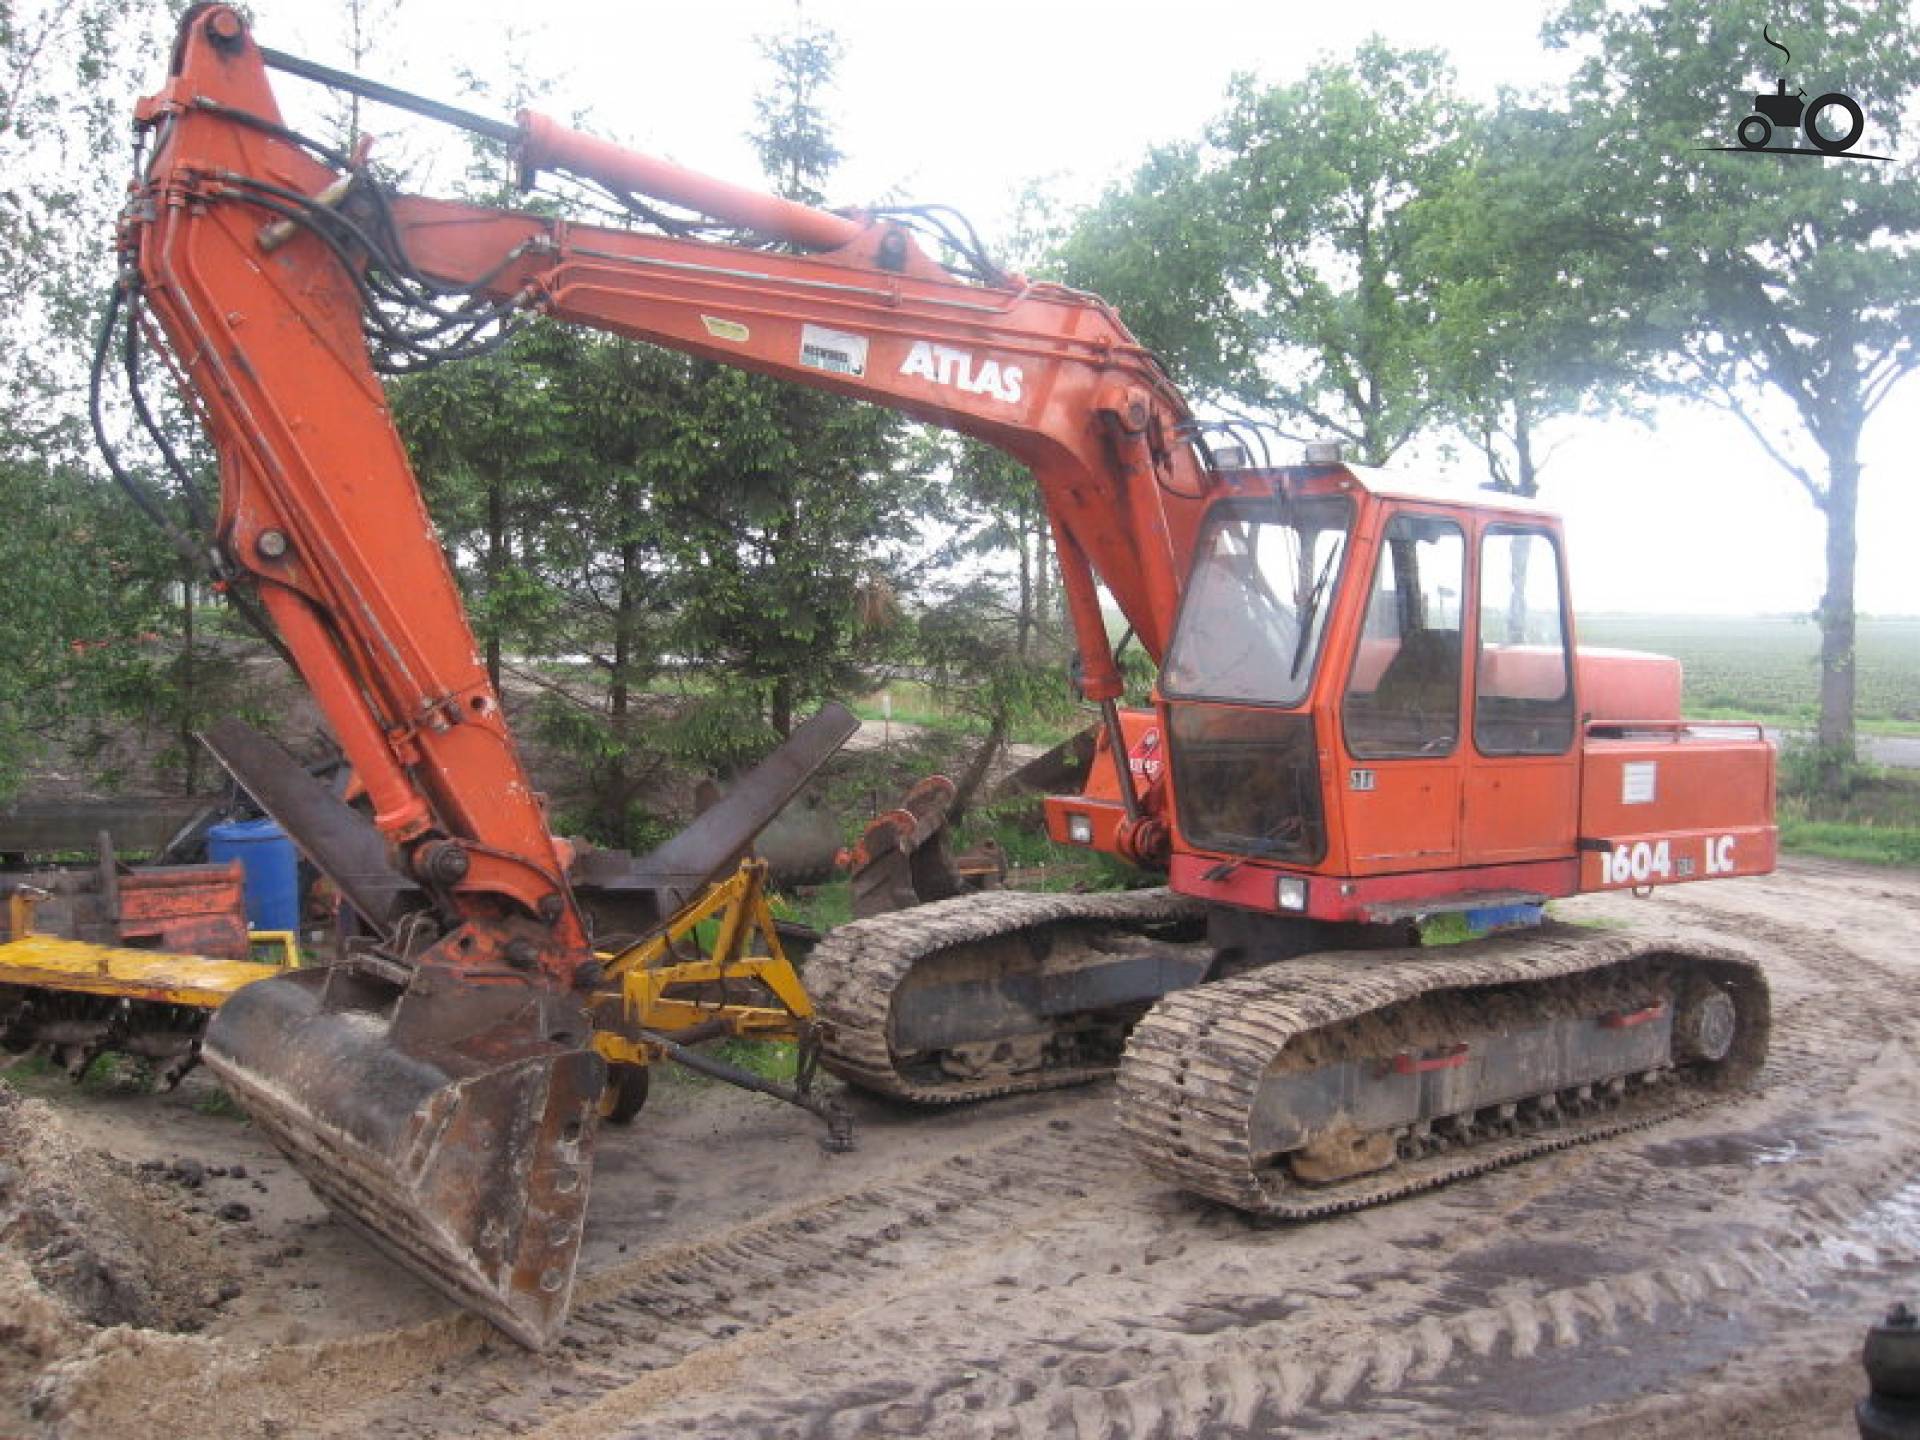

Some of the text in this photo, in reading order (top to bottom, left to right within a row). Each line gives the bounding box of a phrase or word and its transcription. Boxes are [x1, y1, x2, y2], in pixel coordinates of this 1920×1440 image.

[899, 340, 1023, 403] ATLAS
[1601, 840, 1670, 883] 1604
[1705, 834, 1735, 874] LC
